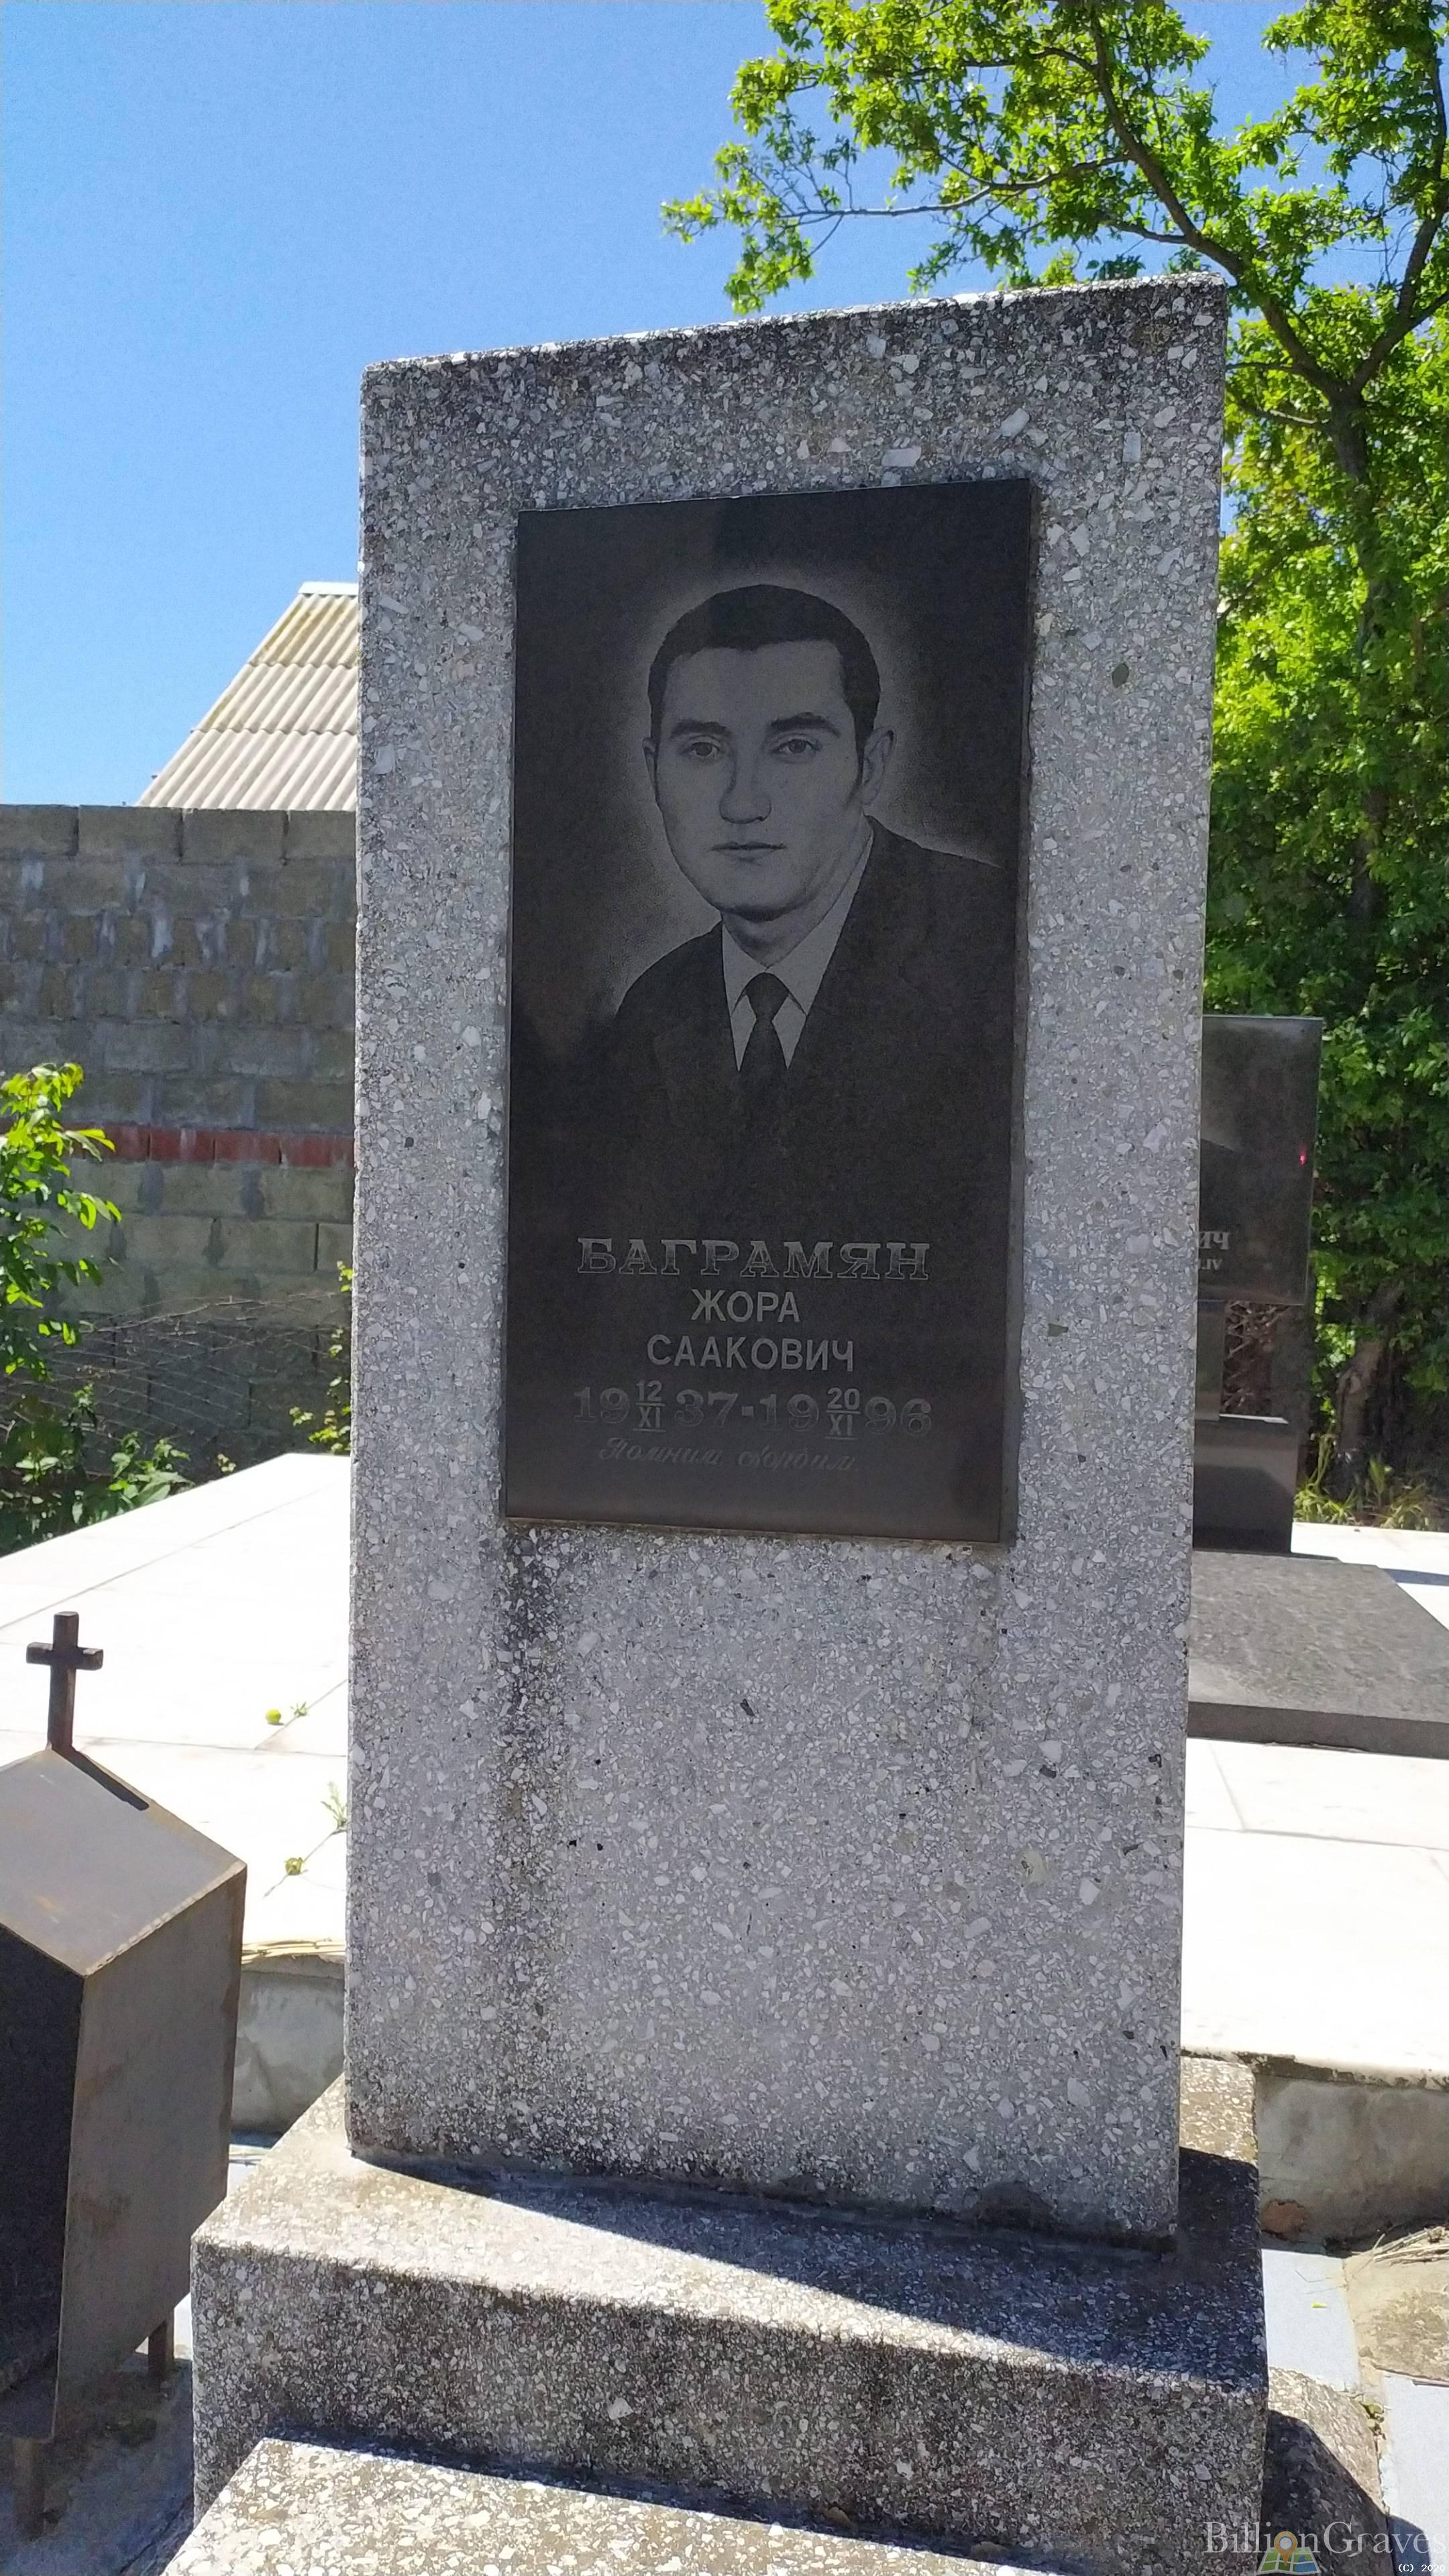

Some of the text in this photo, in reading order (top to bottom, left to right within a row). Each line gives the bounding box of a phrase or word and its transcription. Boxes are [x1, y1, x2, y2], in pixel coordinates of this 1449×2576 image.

[577, 1236, 931, 1281] БАГРАМЯН
[691, 1288, 801, 1323] ЖОРА
[647, 1334, 855, 1372] СААКОВИЧ
[635, 1379, 663, 1402] 12
[826, 1387, 861, 1410] 20
[574, 1386, 631, 1424] 19
[864, 1396, 933, 1437] 96
